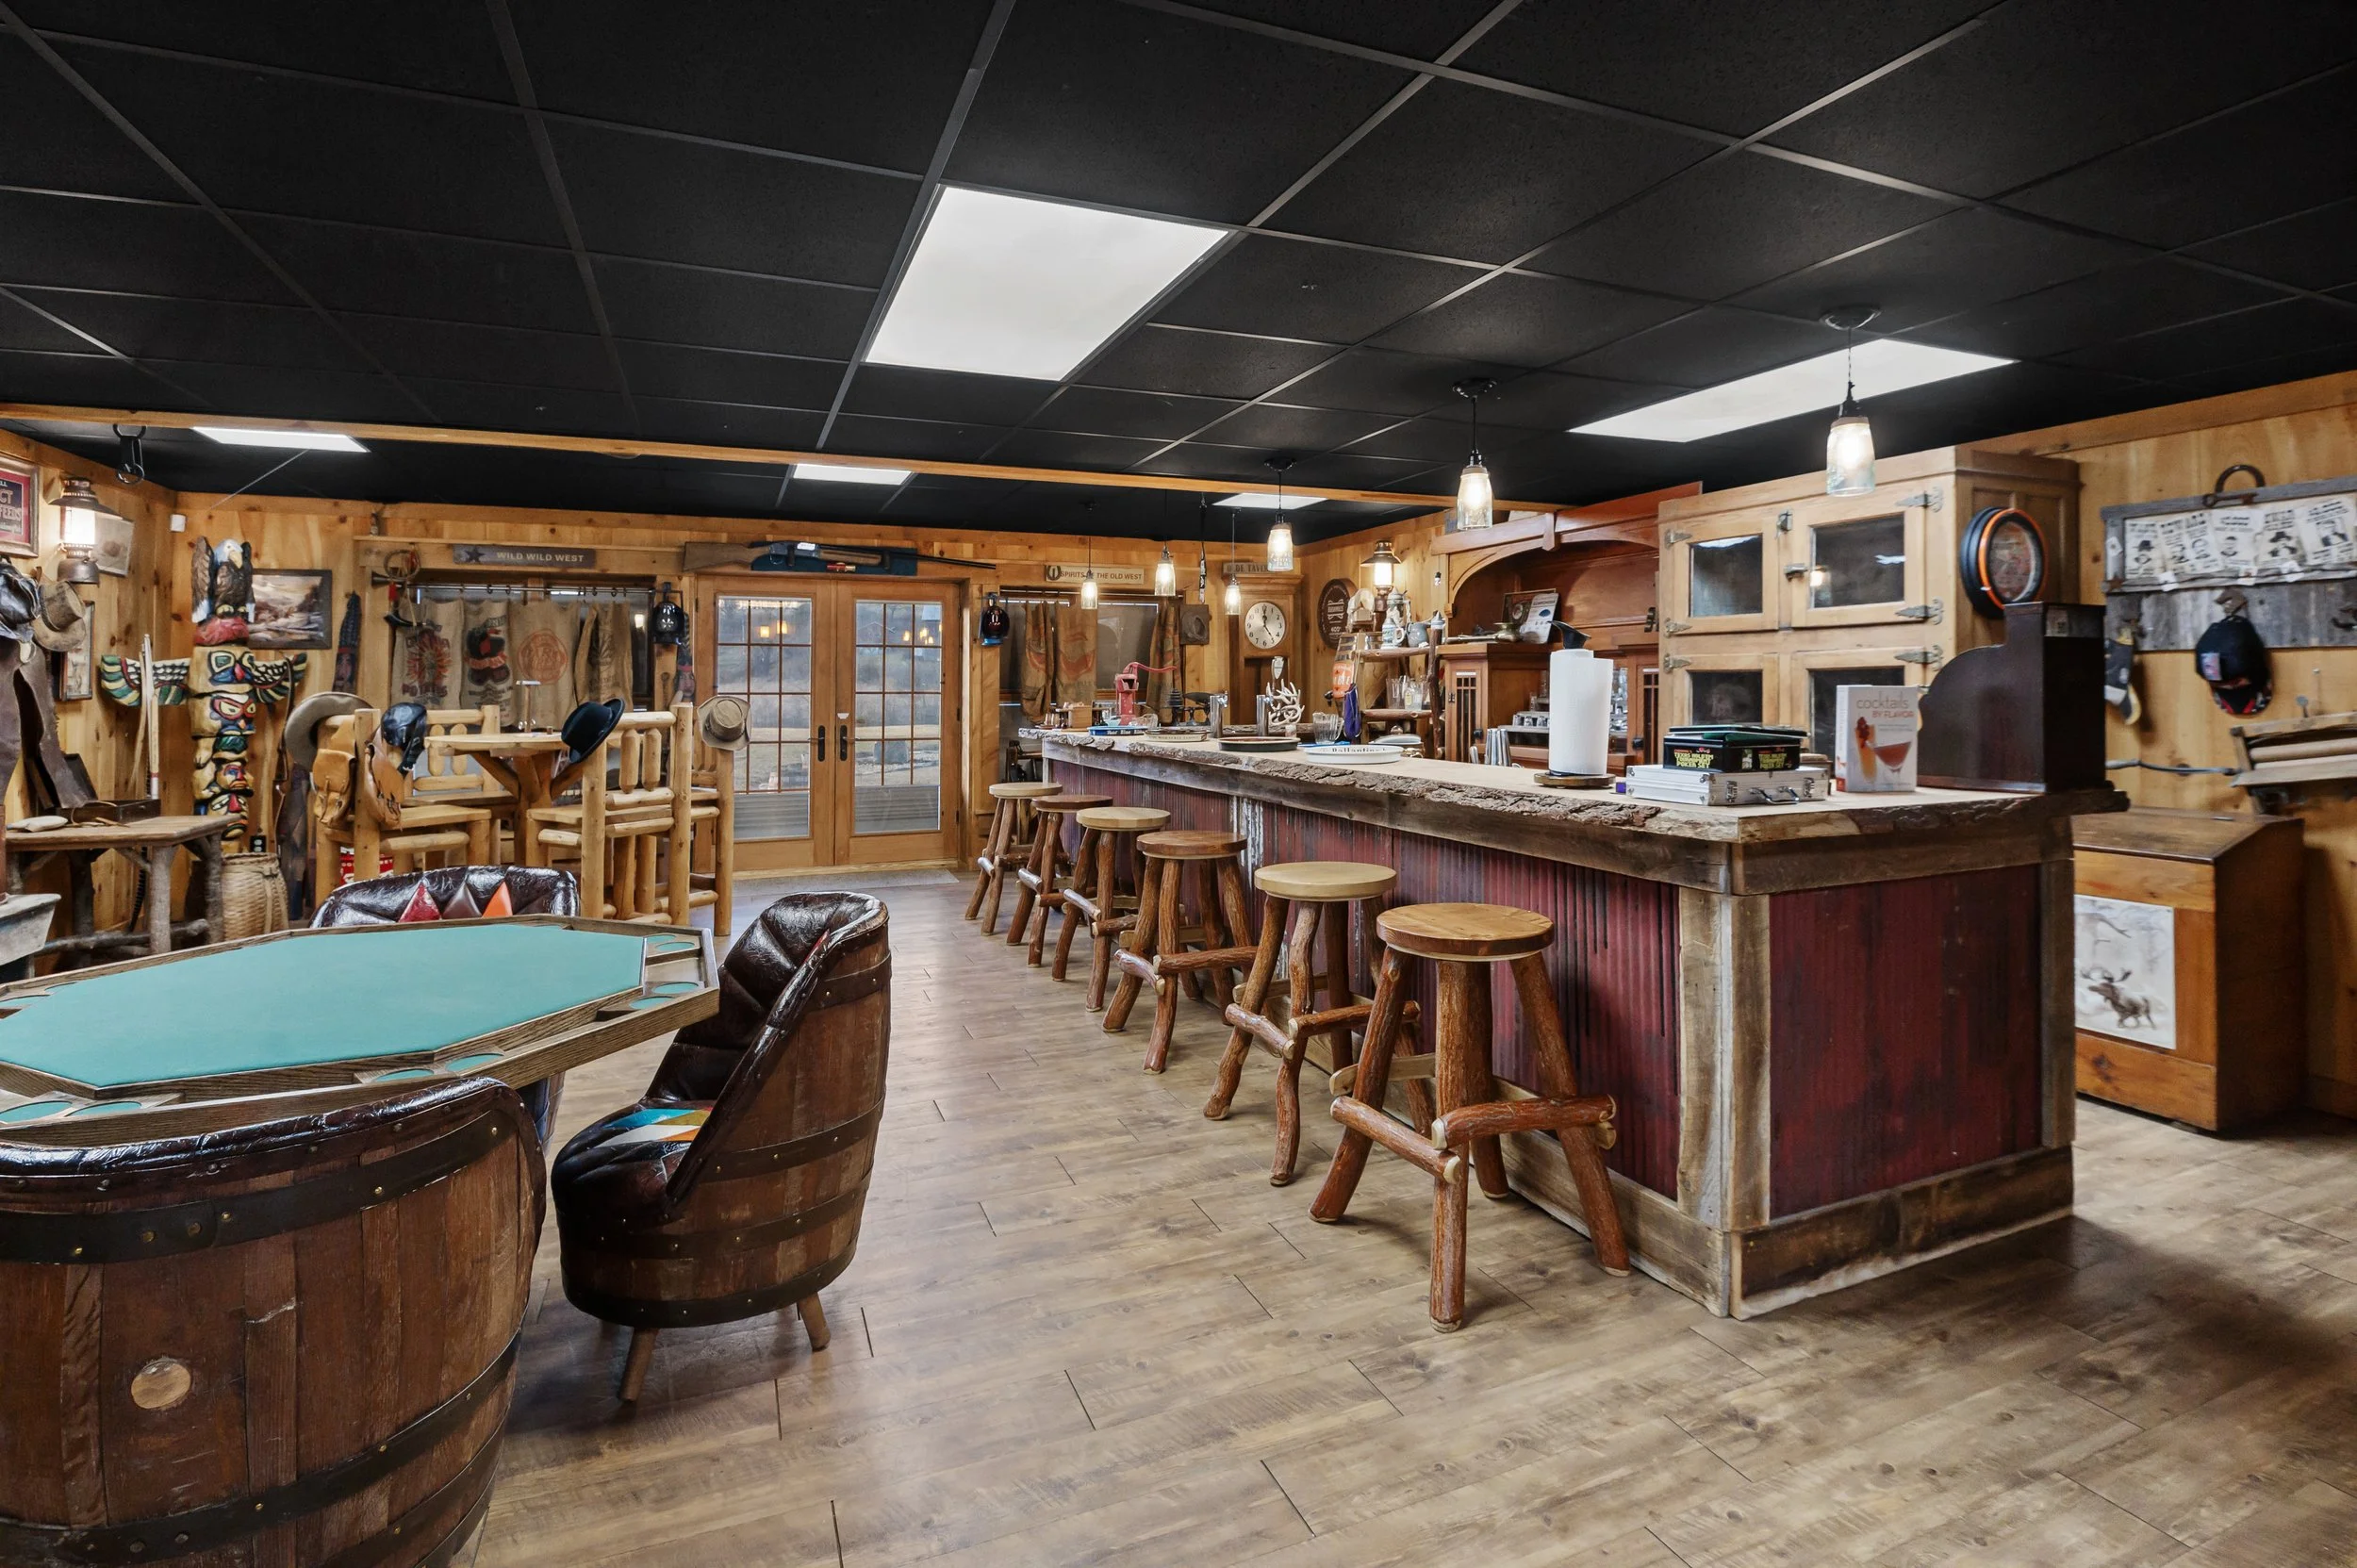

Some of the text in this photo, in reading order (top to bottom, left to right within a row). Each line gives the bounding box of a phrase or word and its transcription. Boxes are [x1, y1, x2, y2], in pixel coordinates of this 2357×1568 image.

[496, 552, 585, 563] WILD WILD WEST
[1227, 564, 1244, 573] ODE
[1856, 691, 1909, 710] cocktails
